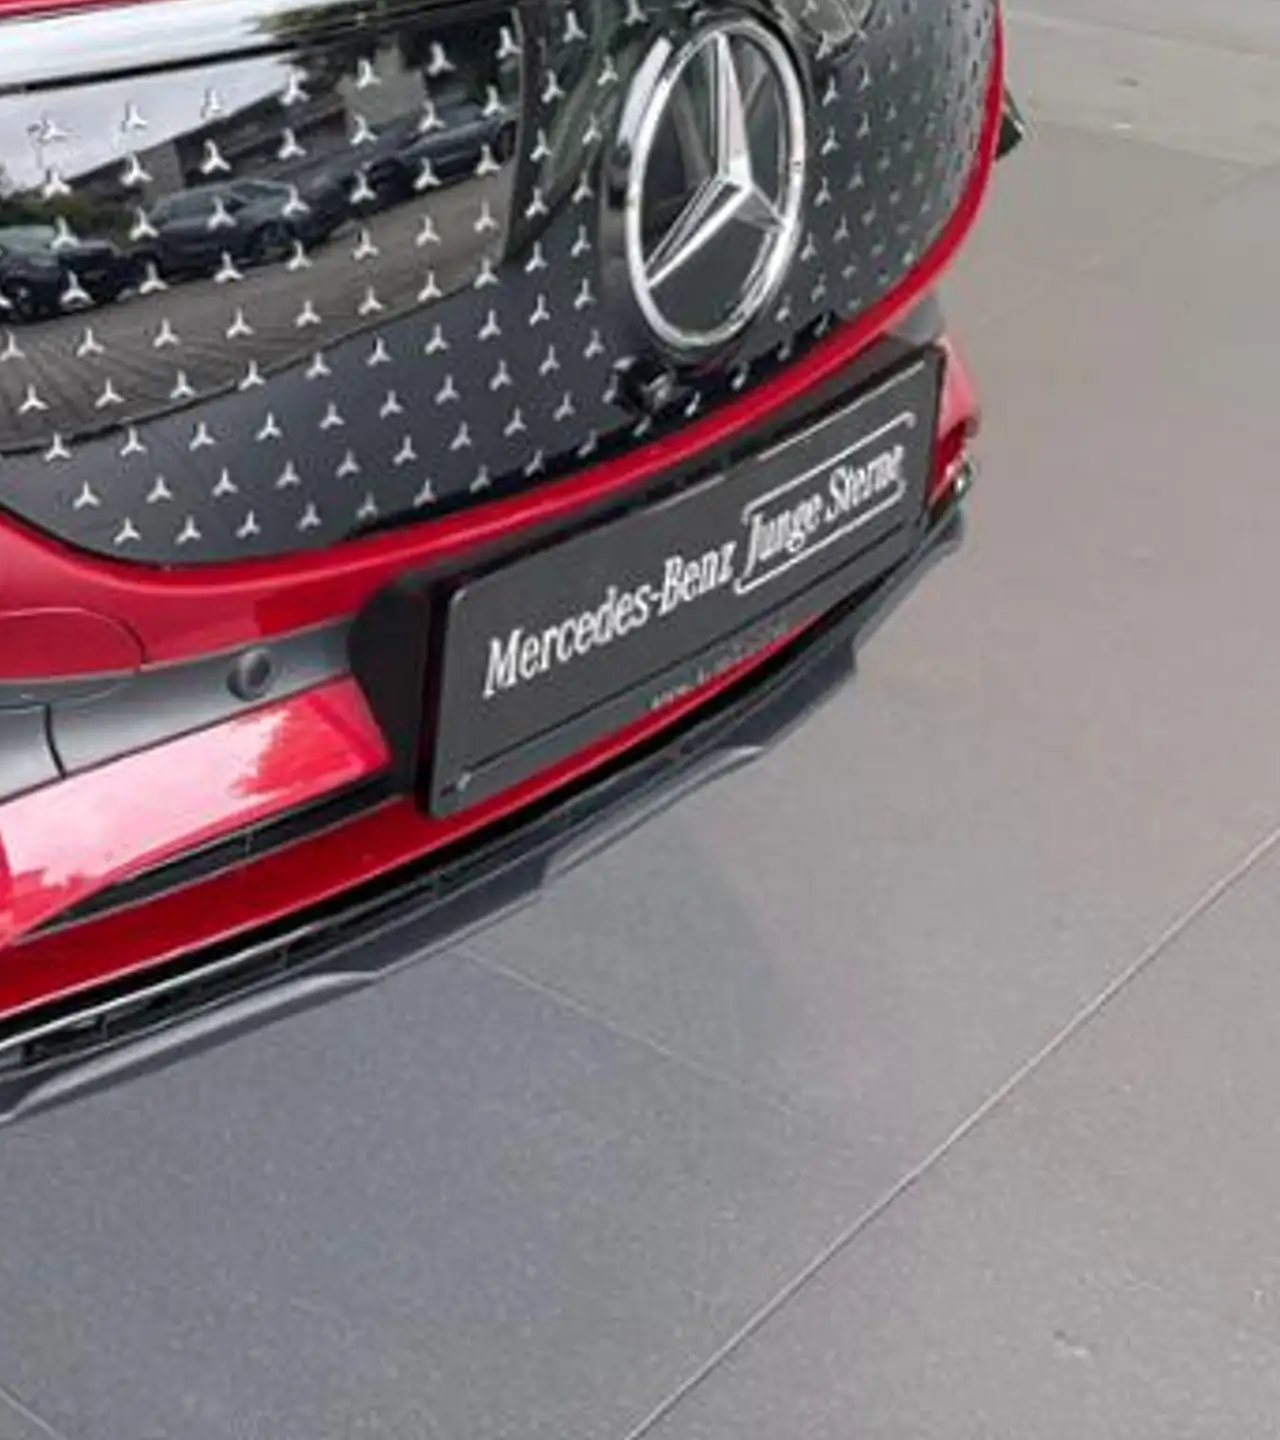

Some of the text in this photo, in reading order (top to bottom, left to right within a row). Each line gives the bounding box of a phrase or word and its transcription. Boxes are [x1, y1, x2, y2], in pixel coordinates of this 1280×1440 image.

[482, 539, 737, 699] Mercedes-Benz
[742, 492, 824, 579] Junge
[824, 444, 905, 524] Sterne
